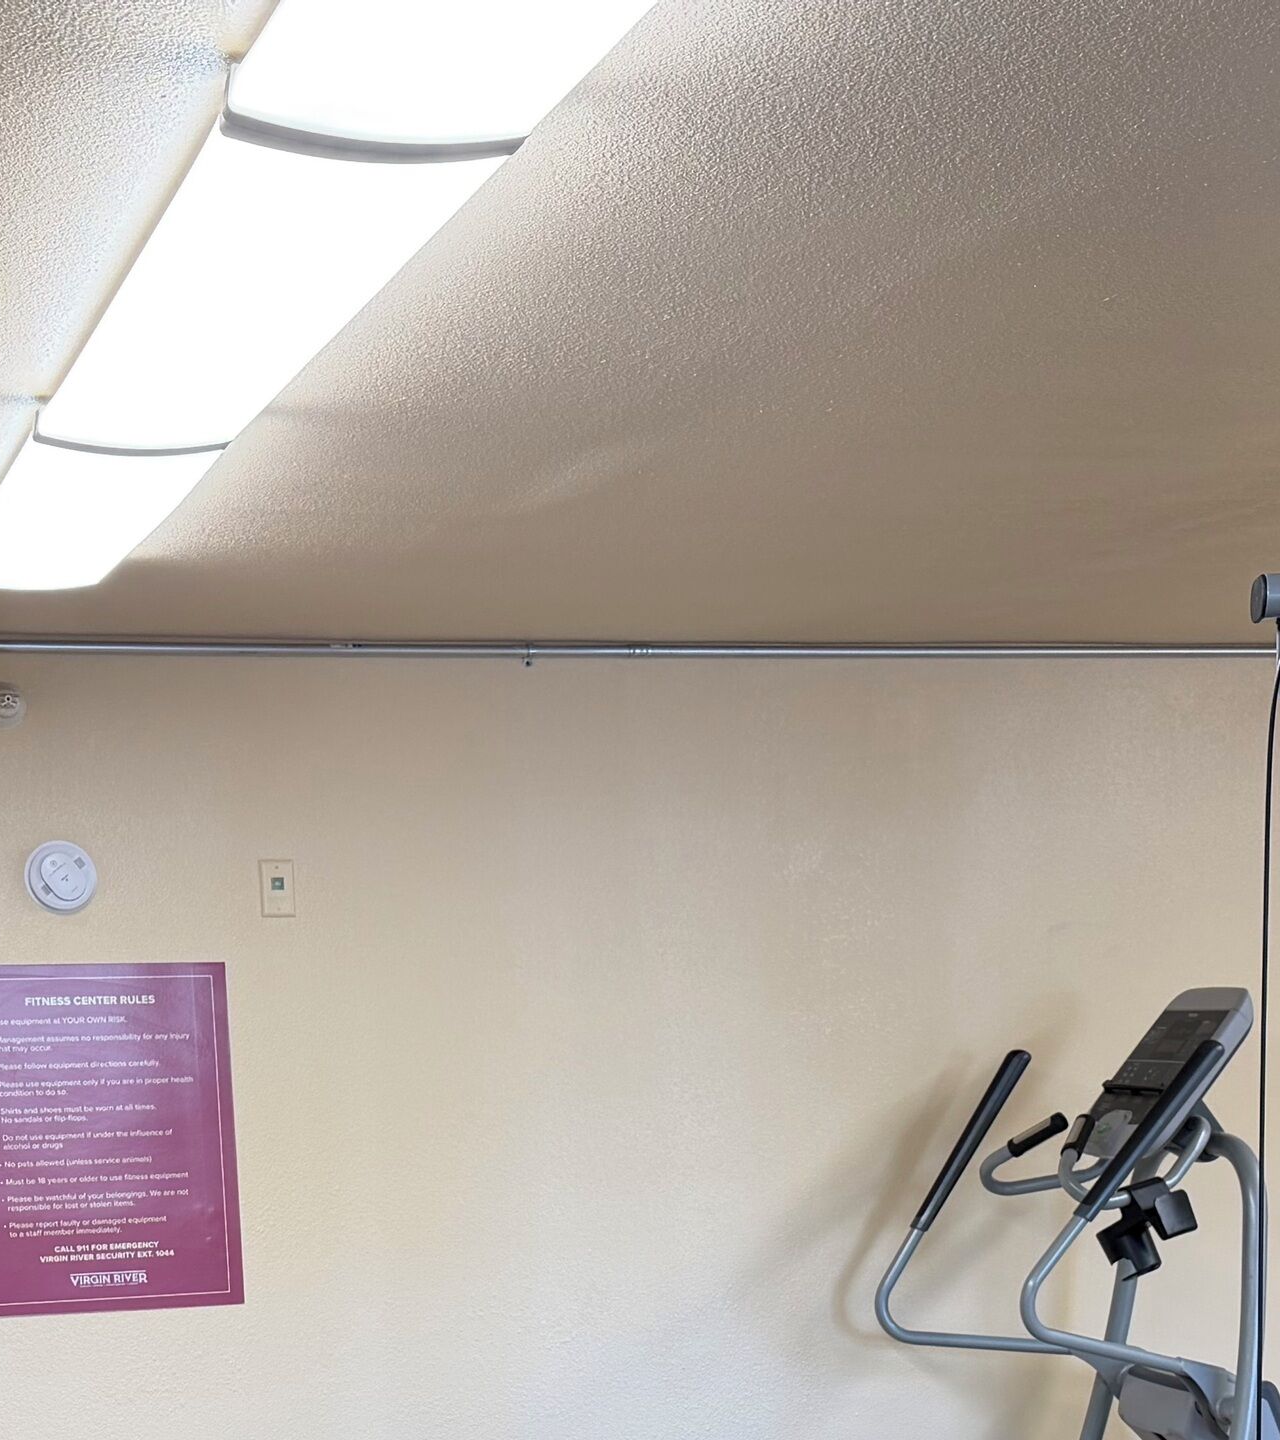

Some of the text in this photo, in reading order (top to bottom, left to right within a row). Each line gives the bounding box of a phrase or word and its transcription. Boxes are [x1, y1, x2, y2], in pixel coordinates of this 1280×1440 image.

[24, 994, 156, 1006] FITNESS CENTER RULES
[10, 1018, 51, 1027] equipment
[62, 1016, 85, 1025] YOUR
[86, 1016, 106, 1024] OWN
[92, 1033, 141, 1042] responsibility
[142, 1032, 153, 1040] for
[154, 1033, 168, 1041] any
[169, 1032, 190, 1041] injury
[12, 1046, 29, 1054] may
[24, 1062, 47, 1070] follow
[48, 1061, 89, 1070] equipment
[90, 1060, 127, 1068] directions
[40, 1080, 81, 1089] equipment
[82, 1079, 99, 1088] only
[106, 1079, 120, 1087] you
[144, 1077, 169, 1086] proper
[170, 1075, 194, 1084] health
[0, 1090, 35, 1098] condition
[0, 1107, 22, 1115] Shirts
[64, 1105, 82, 1113] must
[83, 1105, 94, 1113] be
[124, 1103, 134, 1111] all
[2, 1134, 14, 1142] Do
[44, 1132, 85, 1141] equipment
[93, 1131, 115, 1139] under
[116, 1130, 129, 1138] the
[130, 1129, 164, 1137] influence
[164, 1128, 173, 1136] of
[3, 1142, 31, 1150] alcohol
[41, 1142, 64, 1150] drugs
[17, 1161, 34, 1169] pets
[35, 1159, 65, 1167] allowed
[66, 1159, 93, 1167] (unless
[122, 1155, 153, 1164] animals)
[5, 1178, 24, 1186] Must
[25, 1177, 36, 1185] be
[47, 1177, 68, 1185] years
[149, 1171, 189, 1180] equipment
[45, 1193, 76, 1201] watchful
[87, 1193, 104, 1201] your
[106, 1190, 148, 1199] belongings.
[149, 1189, 161, 1197] We
[176, 1188, 189, 1196] not
[7, 1204, 51, 1212] responsible
[52, 1202, 63, 1210] for
[35, 1220, 59, 1229] report
[60, 1219, 80, 1227] faulty
[91, 1217, 126, 1226] damaged
[127, 1215, 167, 1225] equipment
[25, 1229, 42, 1238] staff
[54, 1245, 75, 1253] CALL
[76, 1244, 89, 1252] 911
[109, 1241, 160, 1250] EMERGENCY
[40, 1249, 175, 1263] VIRGIN RIVER SECURITY EXT. 1044
[70, 1272, 148, 1287] VIRGIN RIVER
